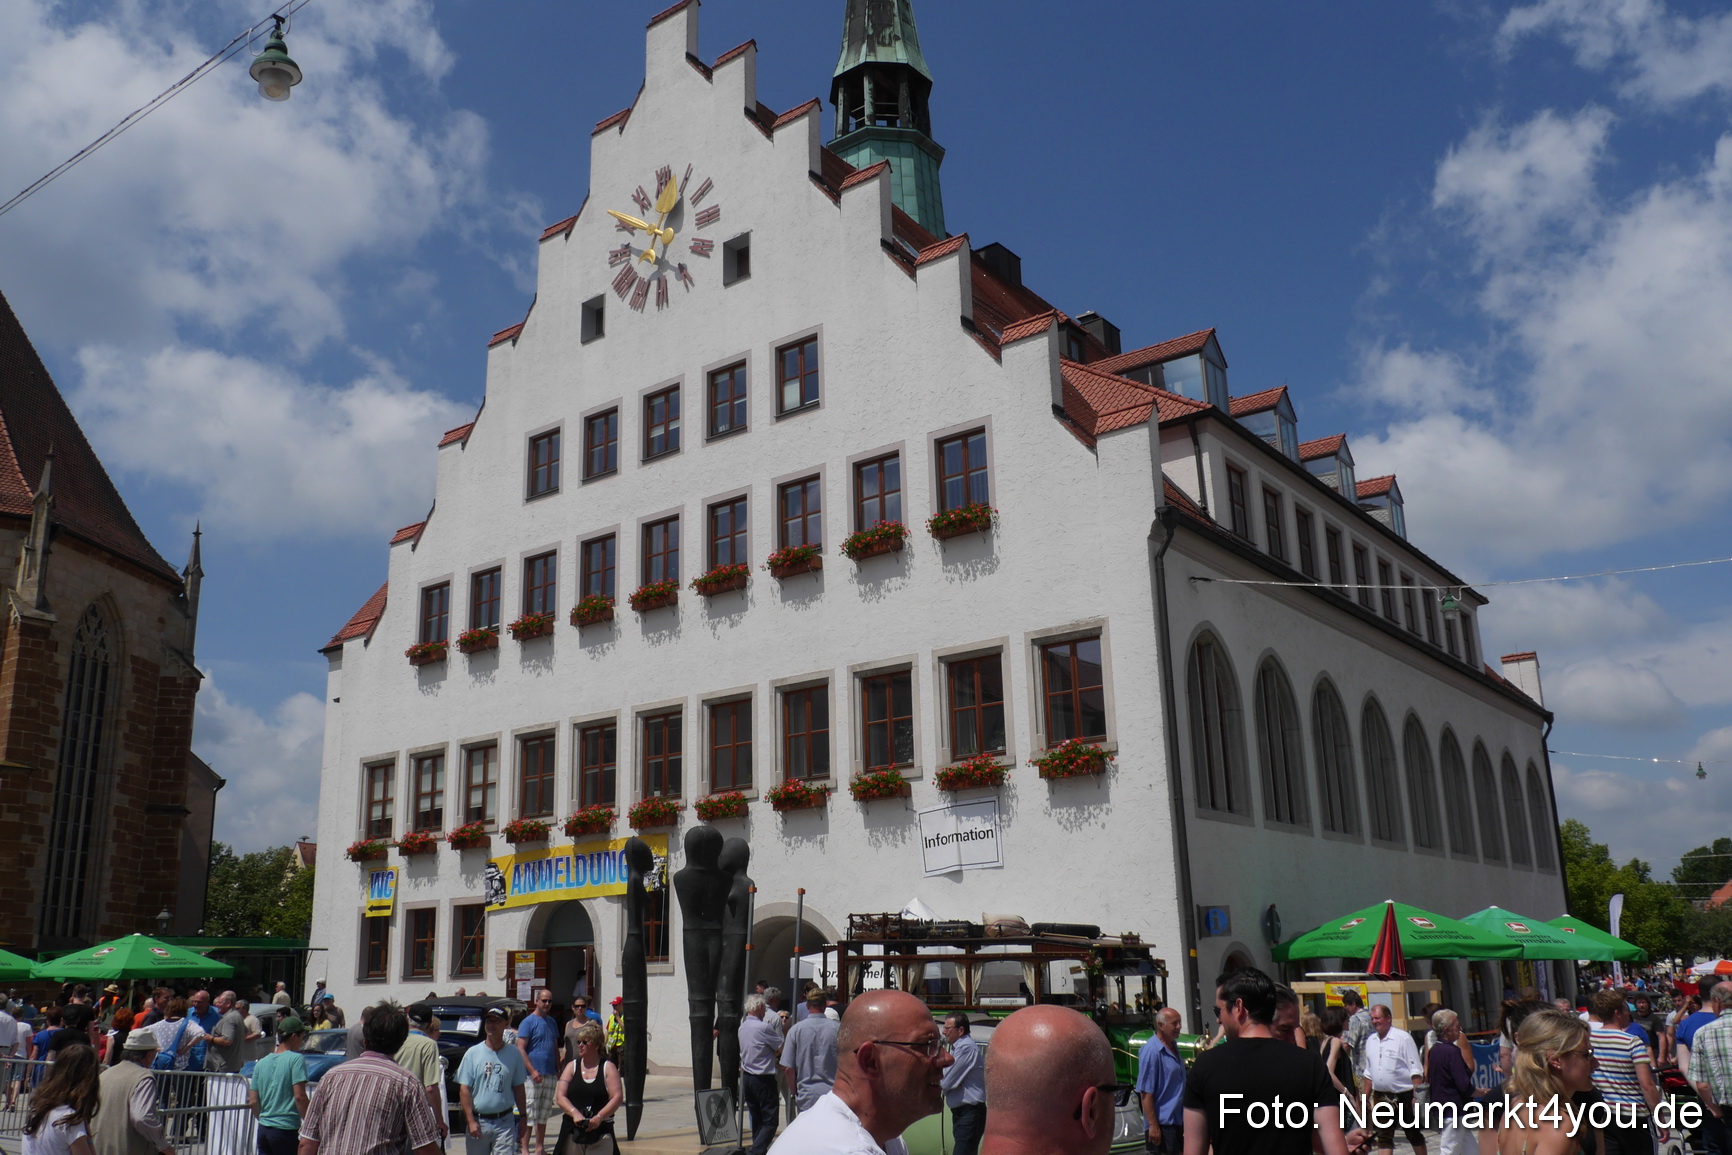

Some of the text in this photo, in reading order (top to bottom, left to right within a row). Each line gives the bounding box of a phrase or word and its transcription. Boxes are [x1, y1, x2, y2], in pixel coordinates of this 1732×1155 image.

[924, 827, 994, 849] Information
[370, 869, 395, 901] WC
[510, 848, 629, 897] ANMELDUNG
